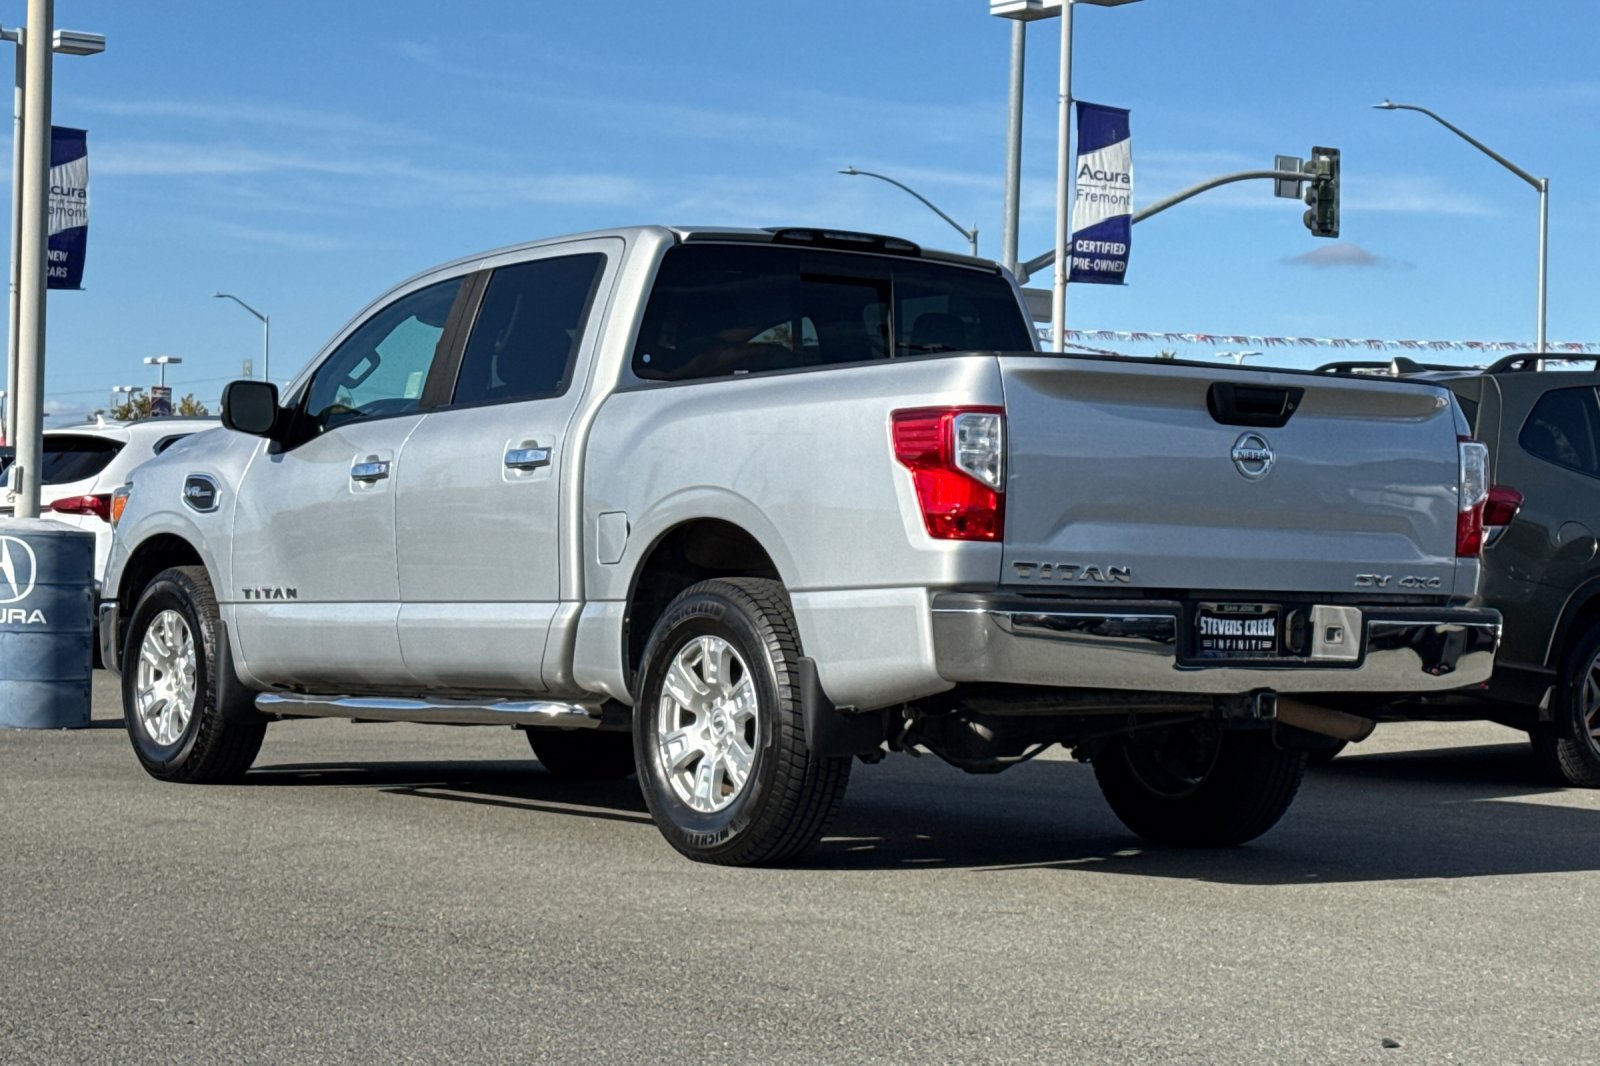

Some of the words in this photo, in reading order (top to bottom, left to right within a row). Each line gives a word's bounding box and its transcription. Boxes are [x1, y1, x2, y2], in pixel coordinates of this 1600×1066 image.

[1077, 163, 1131, 185] Acura
[49, 185, 87, 199] cura
[1076, 188, 1131, 206] Fremont
[47, 249, 69, 262] NEW
[1076, 239, 1127, 256] CERTIFIED
[1072, 256, 1126, 273] PRE-OWNED
[1012, 561, 1131, 584] TITAN
[1353, 573, 1393, 588] SV
[241, 586, 298, 600] TITAN
[1199, 615, 1243, 636] STEVENS
[1244, 617, 1276, 637] CREEK
[1213, 638, 1262, 651] INFINITI
